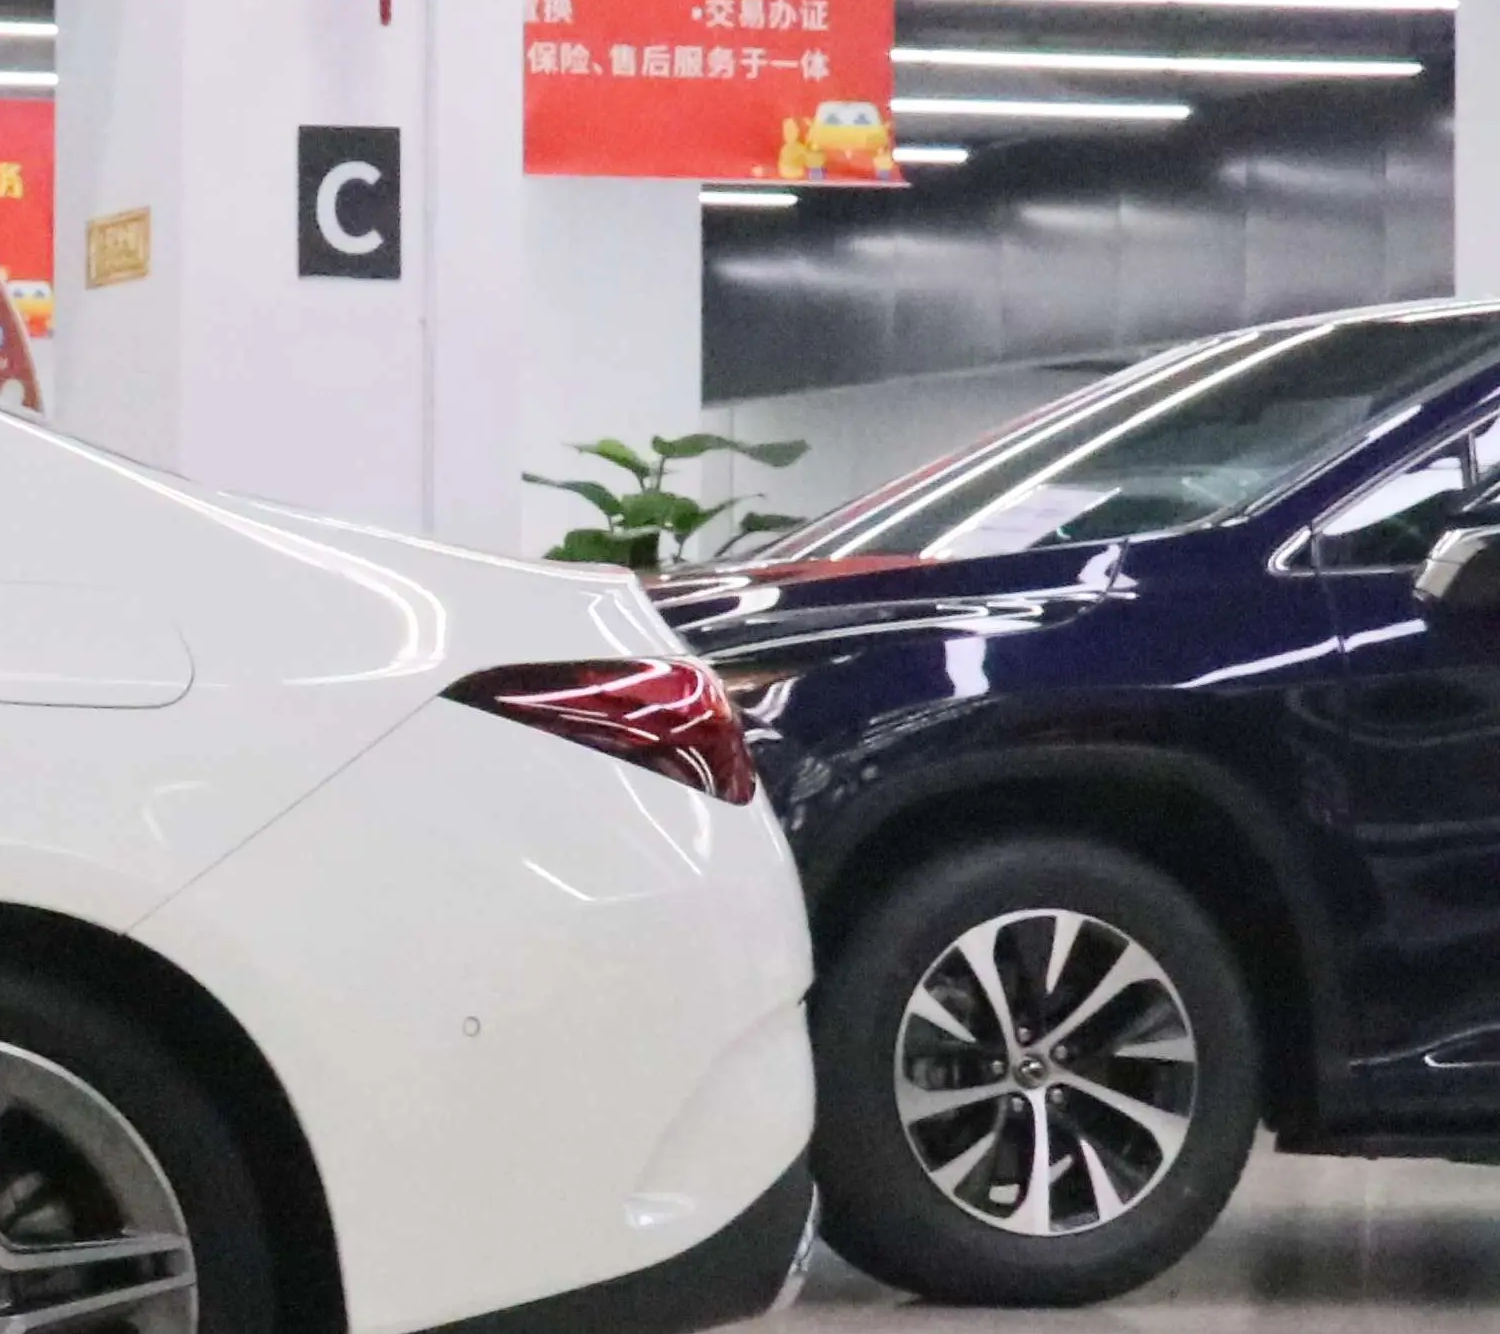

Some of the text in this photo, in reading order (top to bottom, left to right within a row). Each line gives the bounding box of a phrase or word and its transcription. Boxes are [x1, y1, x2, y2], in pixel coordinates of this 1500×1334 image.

[527, 42, 830, 81] 保险、售后服务于一体
[316, 160, 384, 256] C
